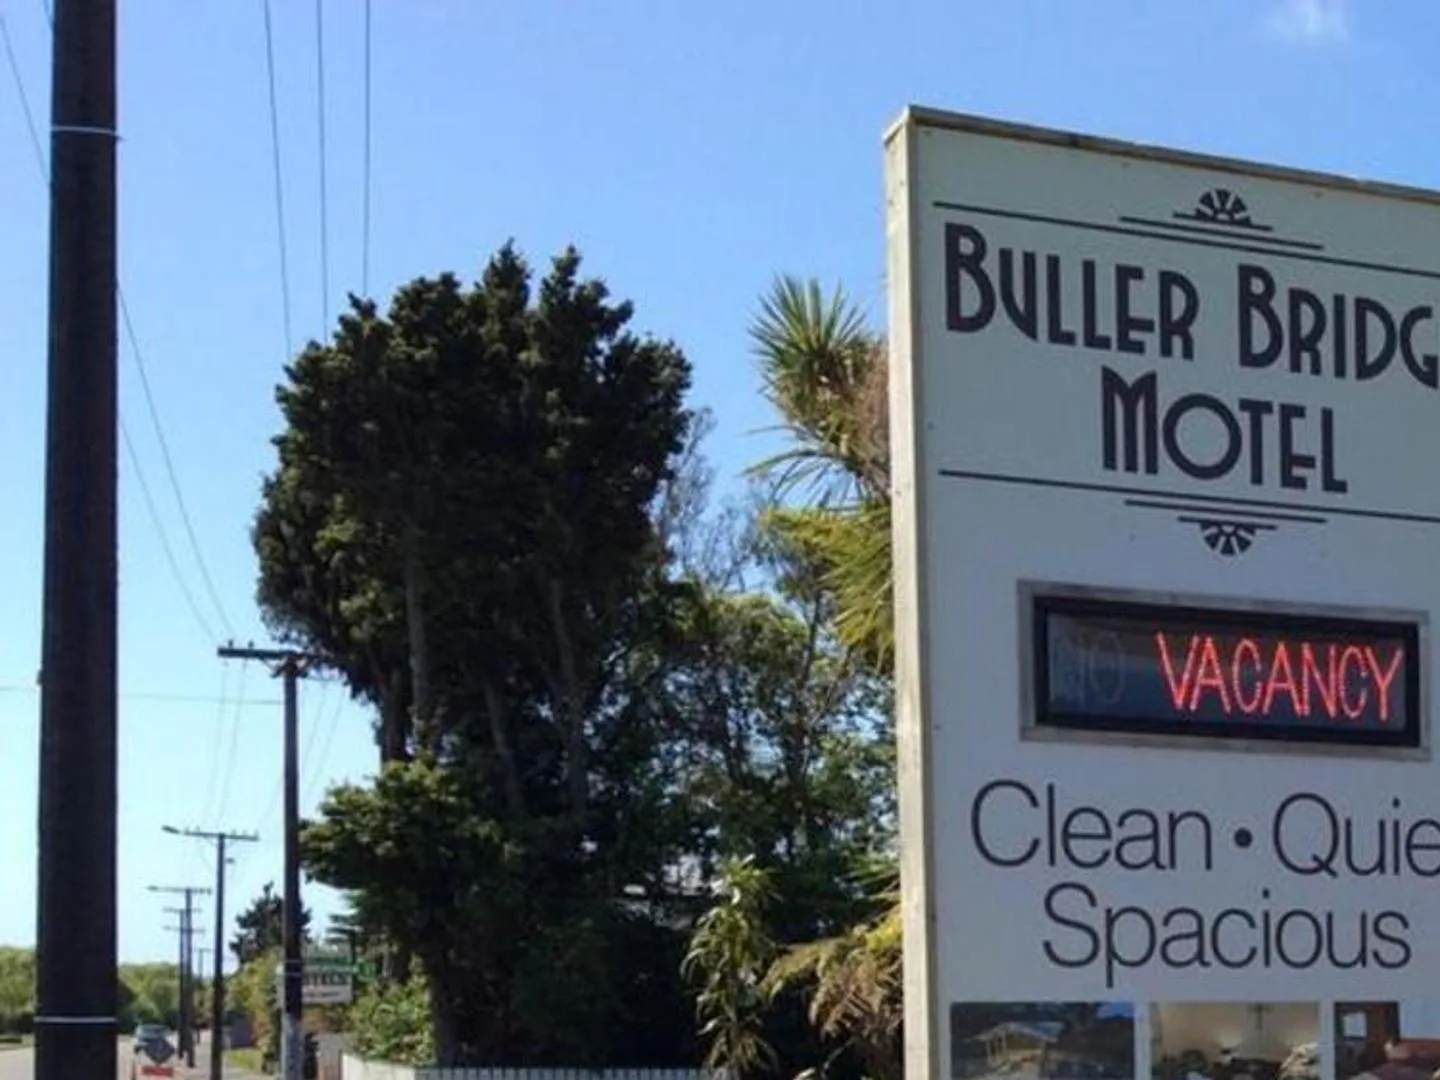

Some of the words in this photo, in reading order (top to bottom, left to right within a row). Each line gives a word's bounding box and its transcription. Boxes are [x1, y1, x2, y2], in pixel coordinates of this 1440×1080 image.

[944, 222, 1200, 361] BULLER
[1101, 366, 1348, 494] MOTEL
[1156, 631, 1404, 722] VACANCY
[971, 779, 1212, 871] Clean
[1042, 882, 1412, 989] Spacious
